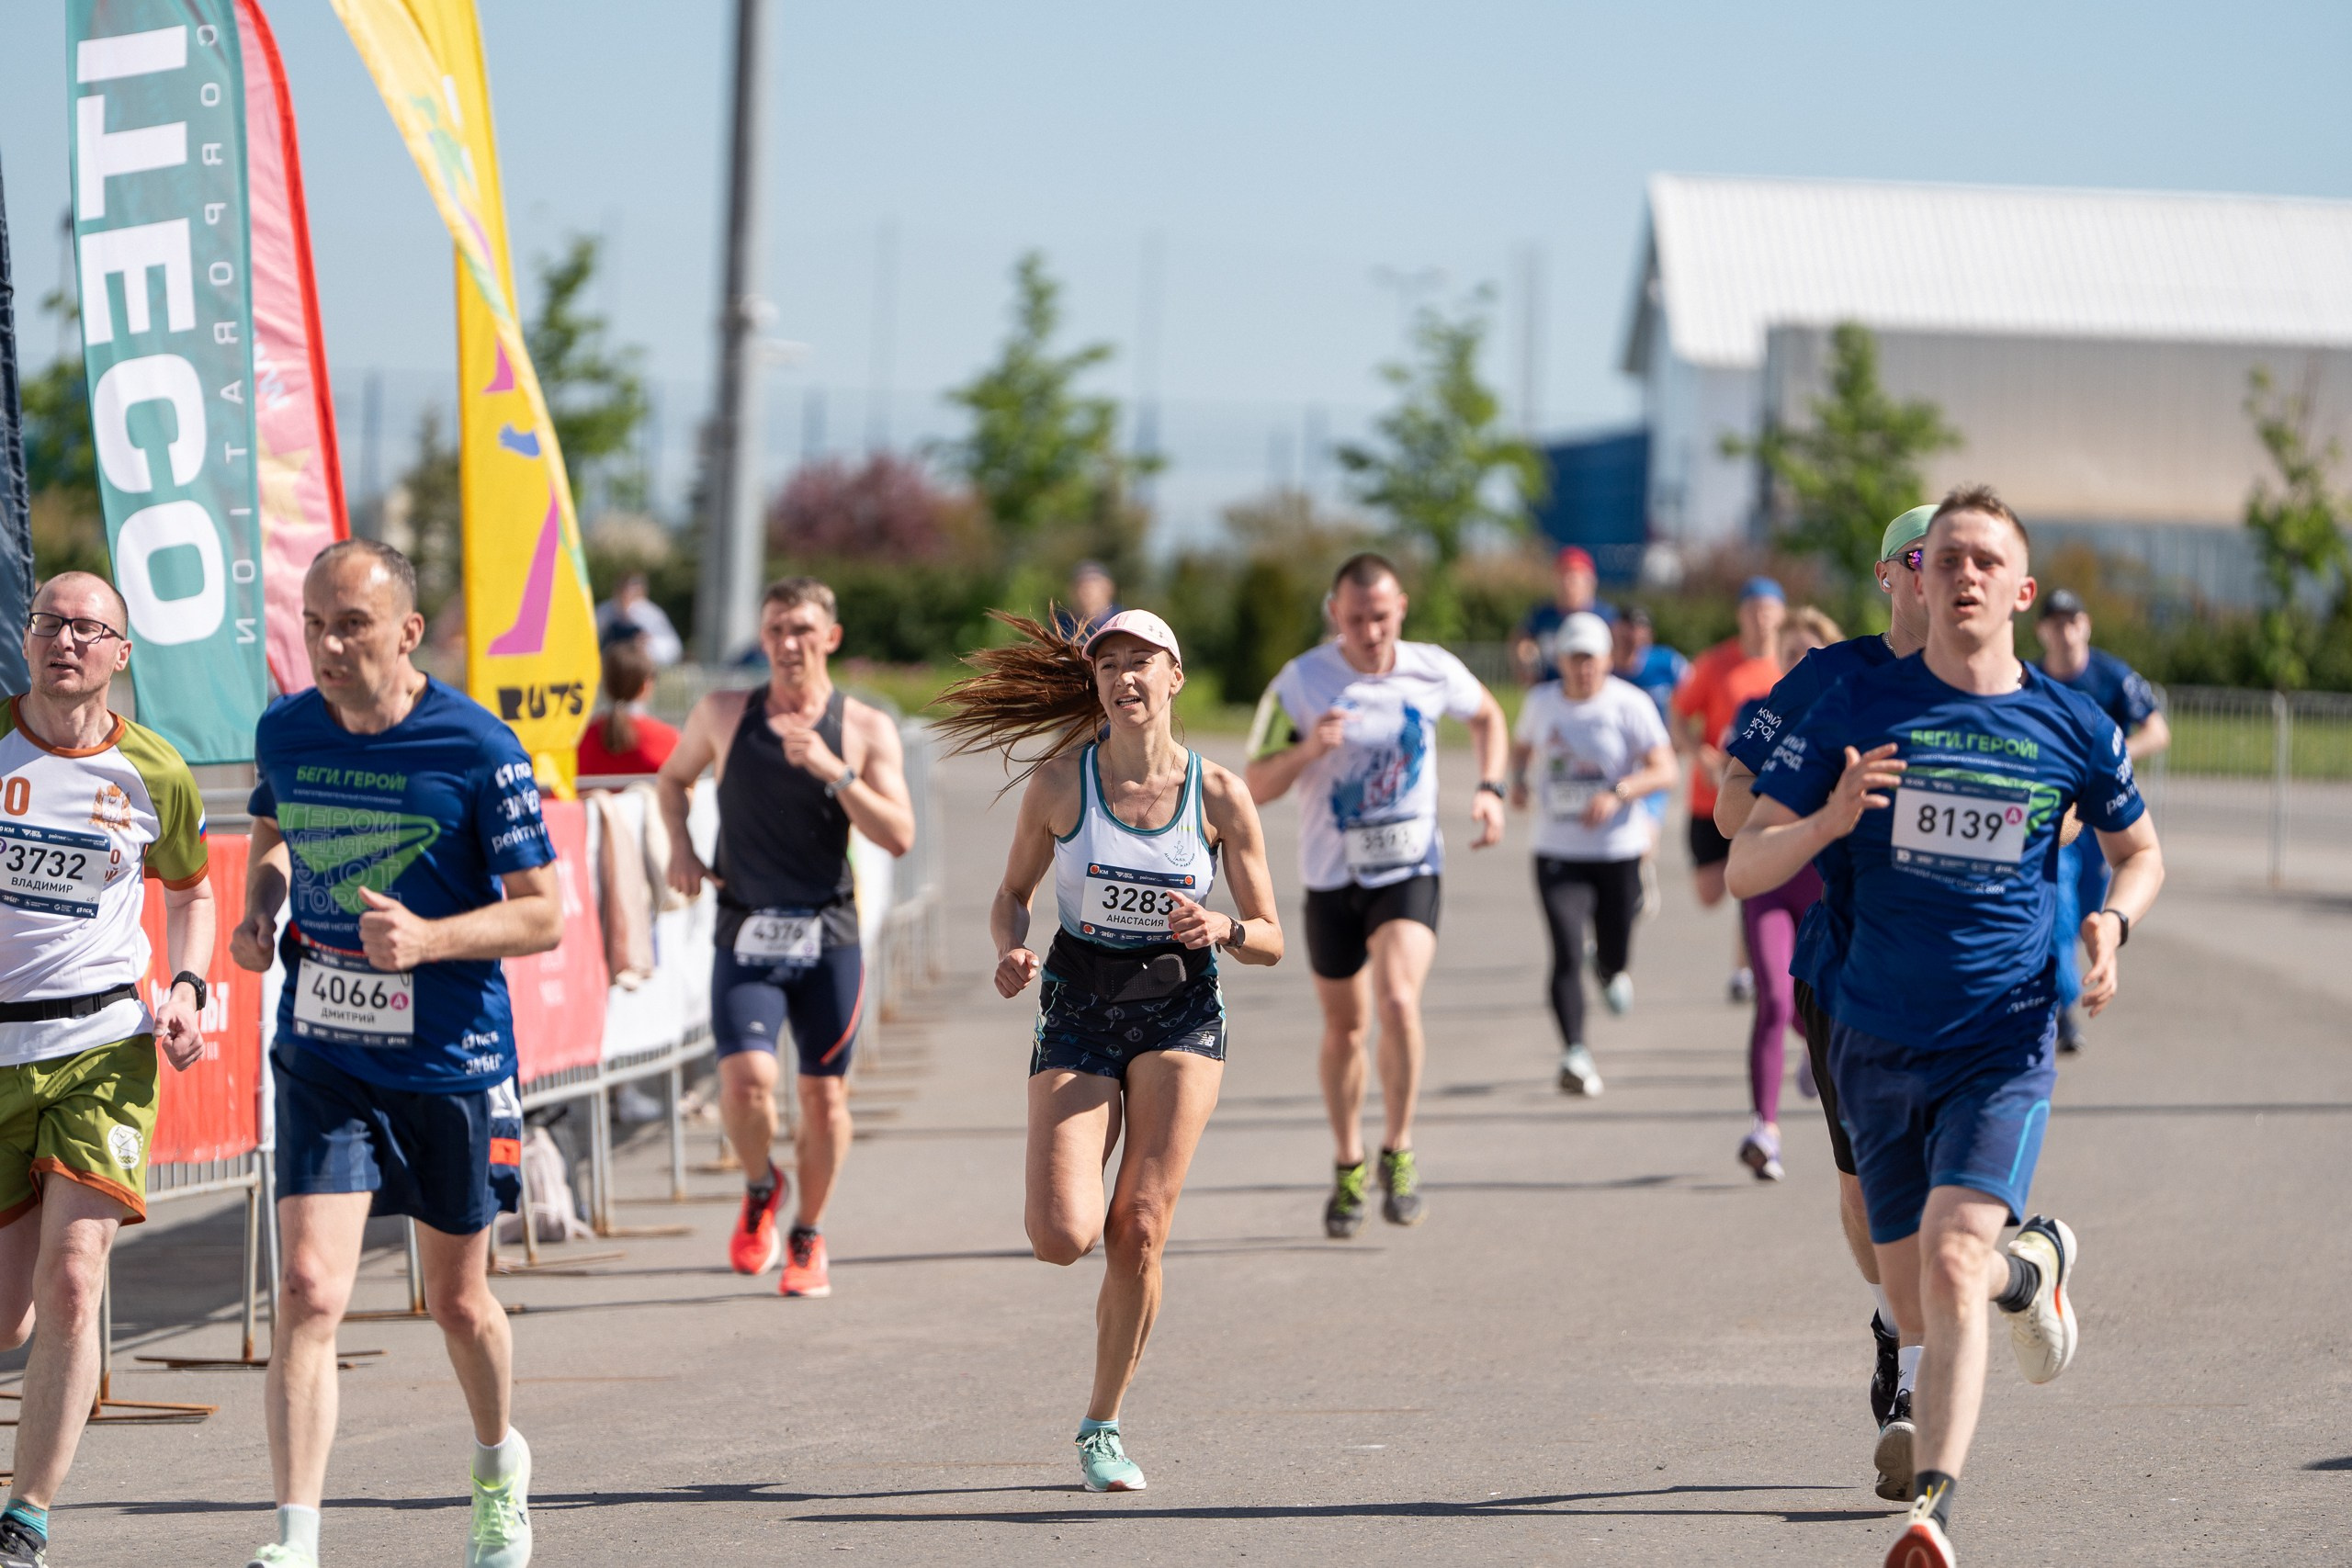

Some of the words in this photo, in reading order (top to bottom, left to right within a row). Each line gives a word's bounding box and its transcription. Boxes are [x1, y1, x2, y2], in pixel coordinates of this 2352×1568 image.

[1917, 804, 2003, 842] 8139
[6, 844, 86, 881] 3732
[11, 877, 74, 894] ВЛАДИМИР
[1102, 886, 1173, 915] 3283
[1106, 914, 1164, 927] АНАСТАСИЯ
[312, 972, 388, 1010] 4066
[321, 1008, 377, 1024] ДМИТРИЙ
